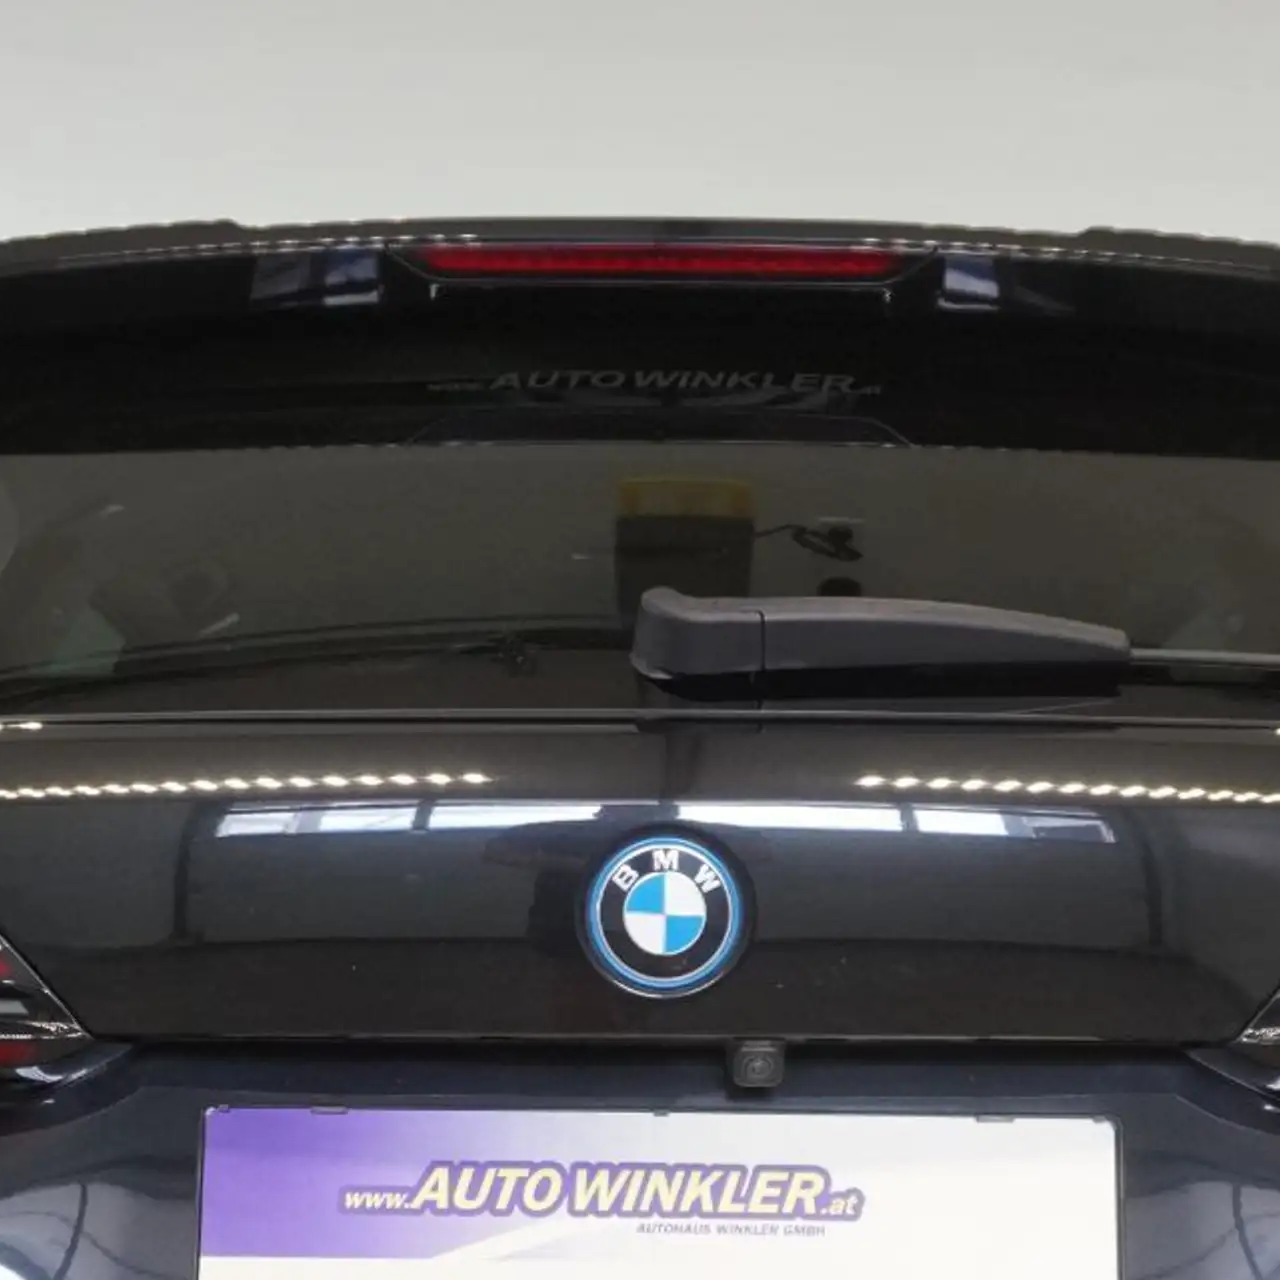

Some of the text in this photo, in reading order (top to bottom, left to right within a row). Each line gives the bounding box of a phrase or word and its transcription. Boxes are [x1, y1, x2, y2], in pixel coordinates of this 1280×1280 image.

[611, 849, 721, 893] BMW
[636, 1223, 827, 1238] AUTOHAUS WINKLER GMBH
